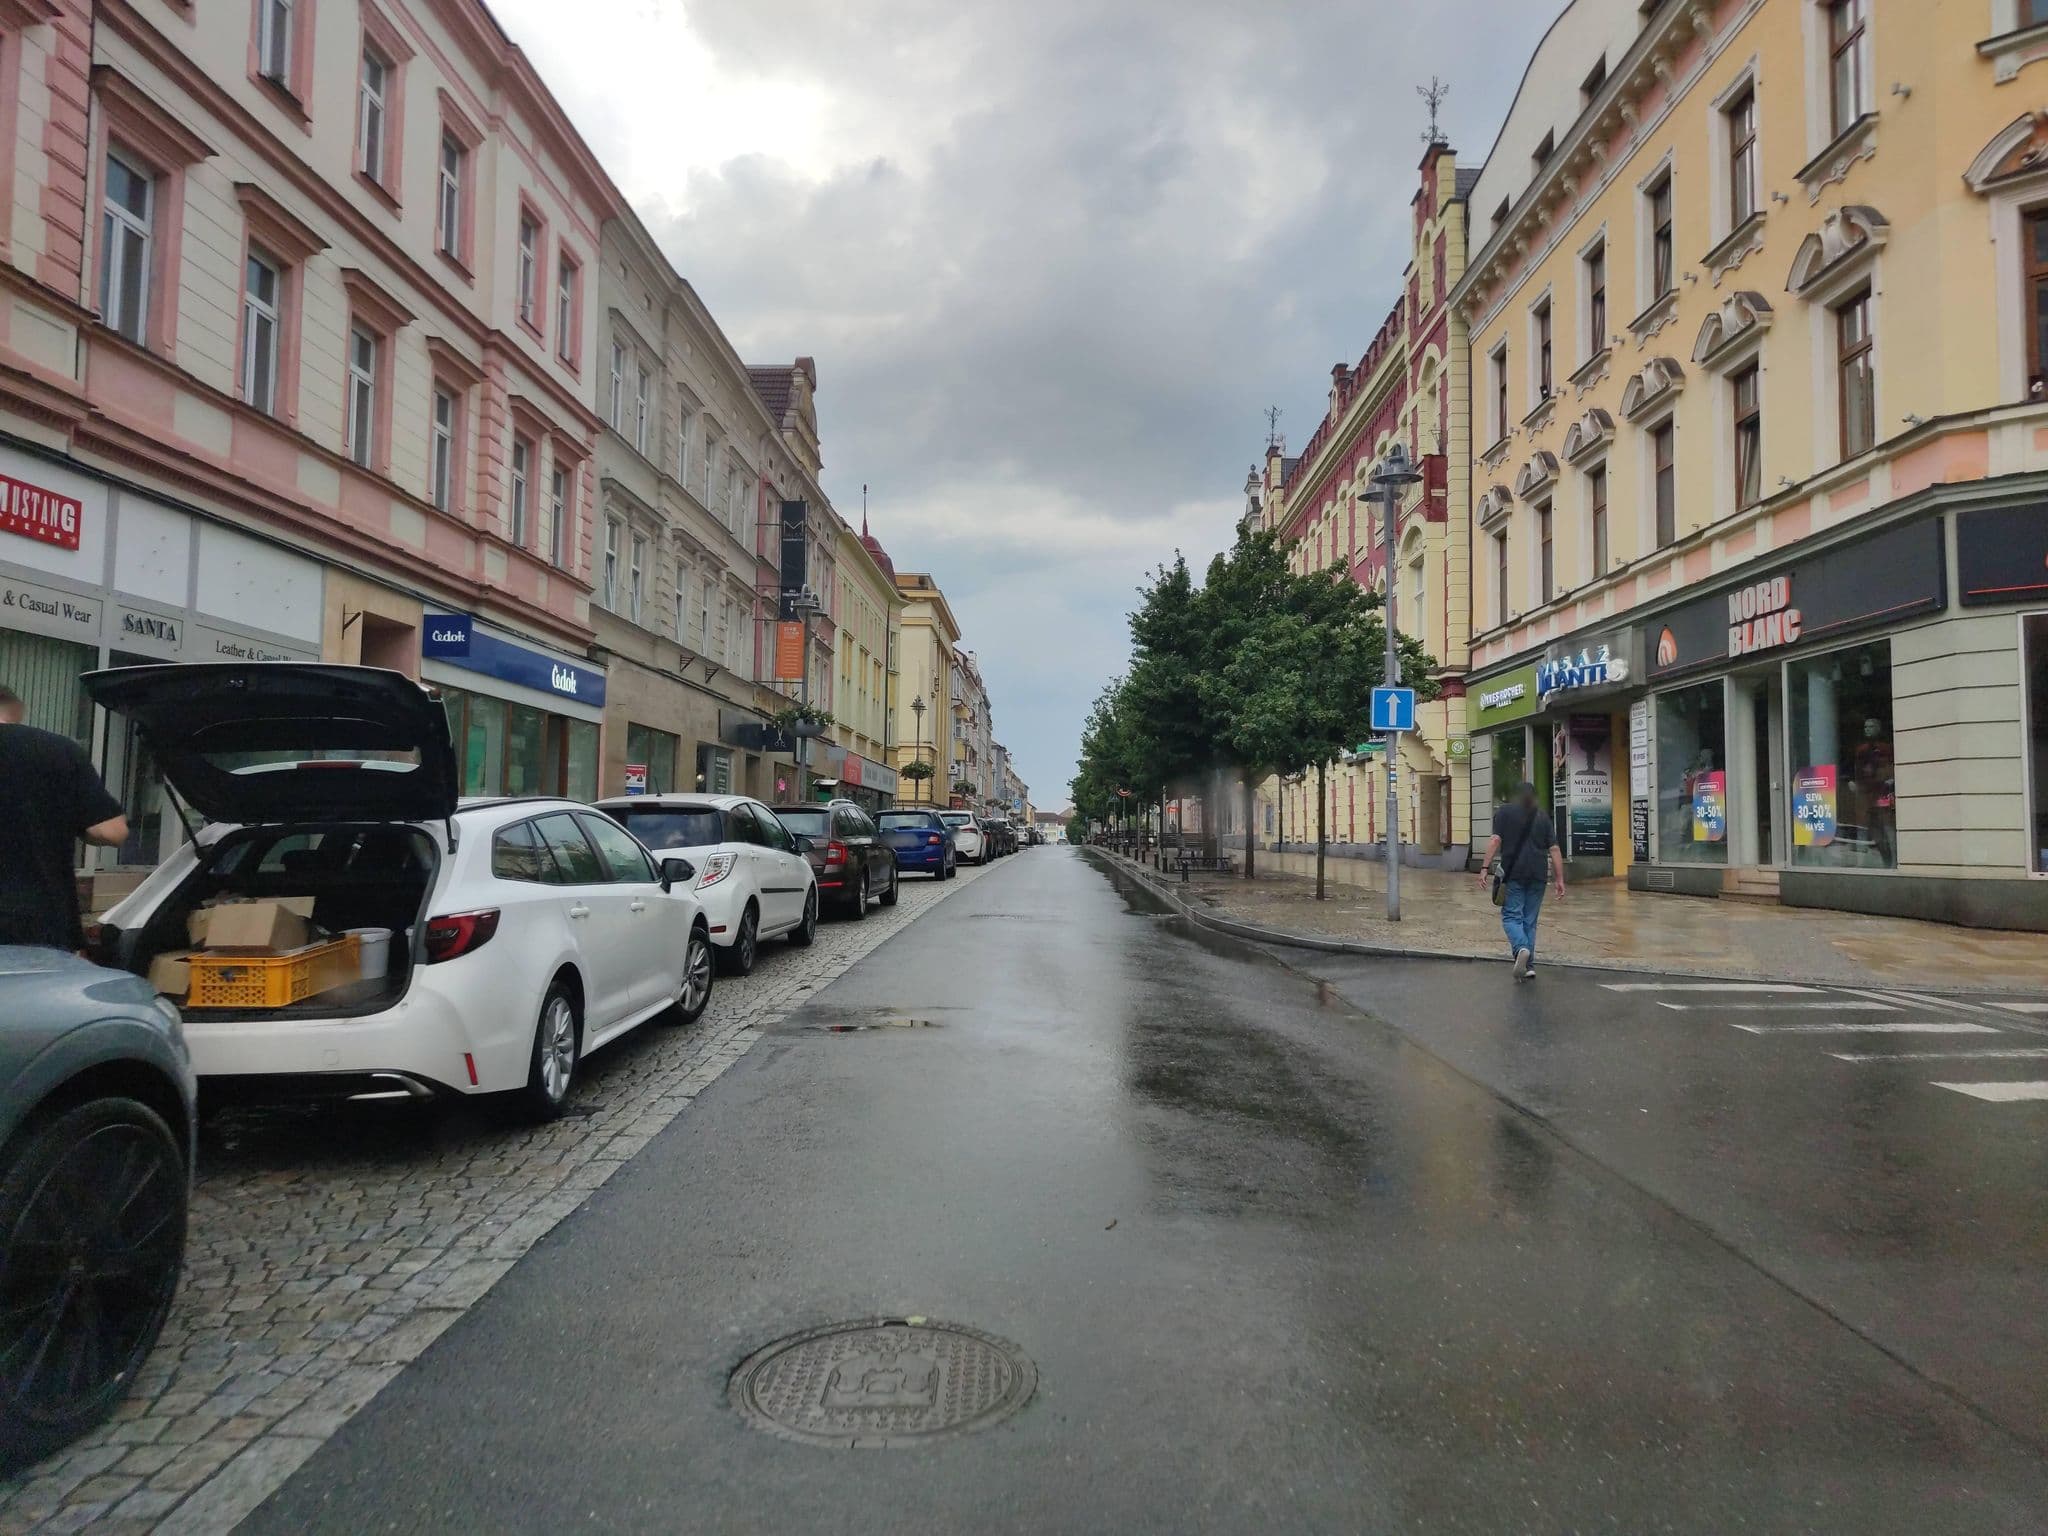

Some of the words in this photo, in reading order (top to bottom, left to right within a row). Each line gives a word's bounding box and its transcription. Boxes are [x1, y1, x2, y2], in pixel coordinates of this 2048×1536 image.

[19, 593, 58, 617] Casual
[62, 602, 91, 624] Wear
[1728, 576, 1791, 625] NORD
[124, 613, 177, 642] SANTA
[1728, 608, 1803, 658] BLANC
[216, 640, 245, 658] Leather
[1805, 793, 1823, 802] SLEVA
